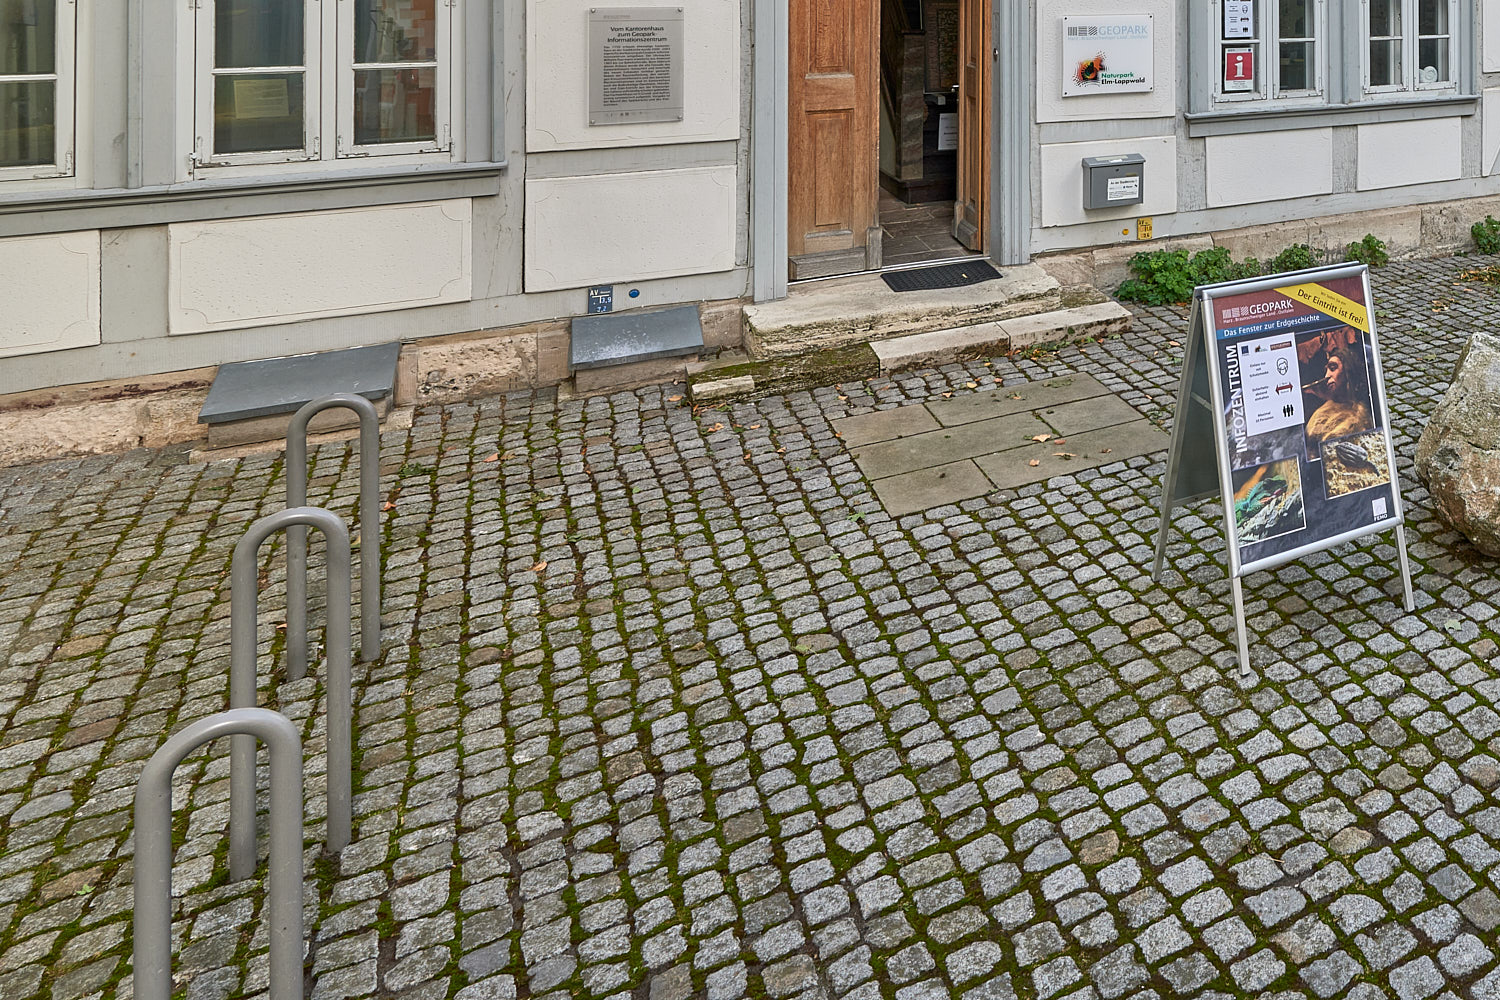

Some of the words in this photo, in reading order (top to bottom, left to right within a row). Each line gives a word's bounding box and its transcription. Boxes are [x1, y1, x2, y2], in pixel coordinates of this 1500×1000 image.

[1098, 25, 1148, 36] GEOPARK
[1101, 71, 1134, 79] Naturpark
[1249, 299, 1293, 315] GEOPARK
[1297, 288, 1312, 301] Der
[1312, 295, 1338, 313] Eintritt
[1338, 307, 1348, 319] ist
[1348, 312, 1364, 326] frei!
[1224, 329, 1237, 337] Das
[1238, 324, 1263, 335] Fenster
[1276, 314, 1320, 328] Erdgeschichte
[1225, 344, 1248, 453] INFOZENTRUM
[1373, 513, 1388, 521] FEMO
